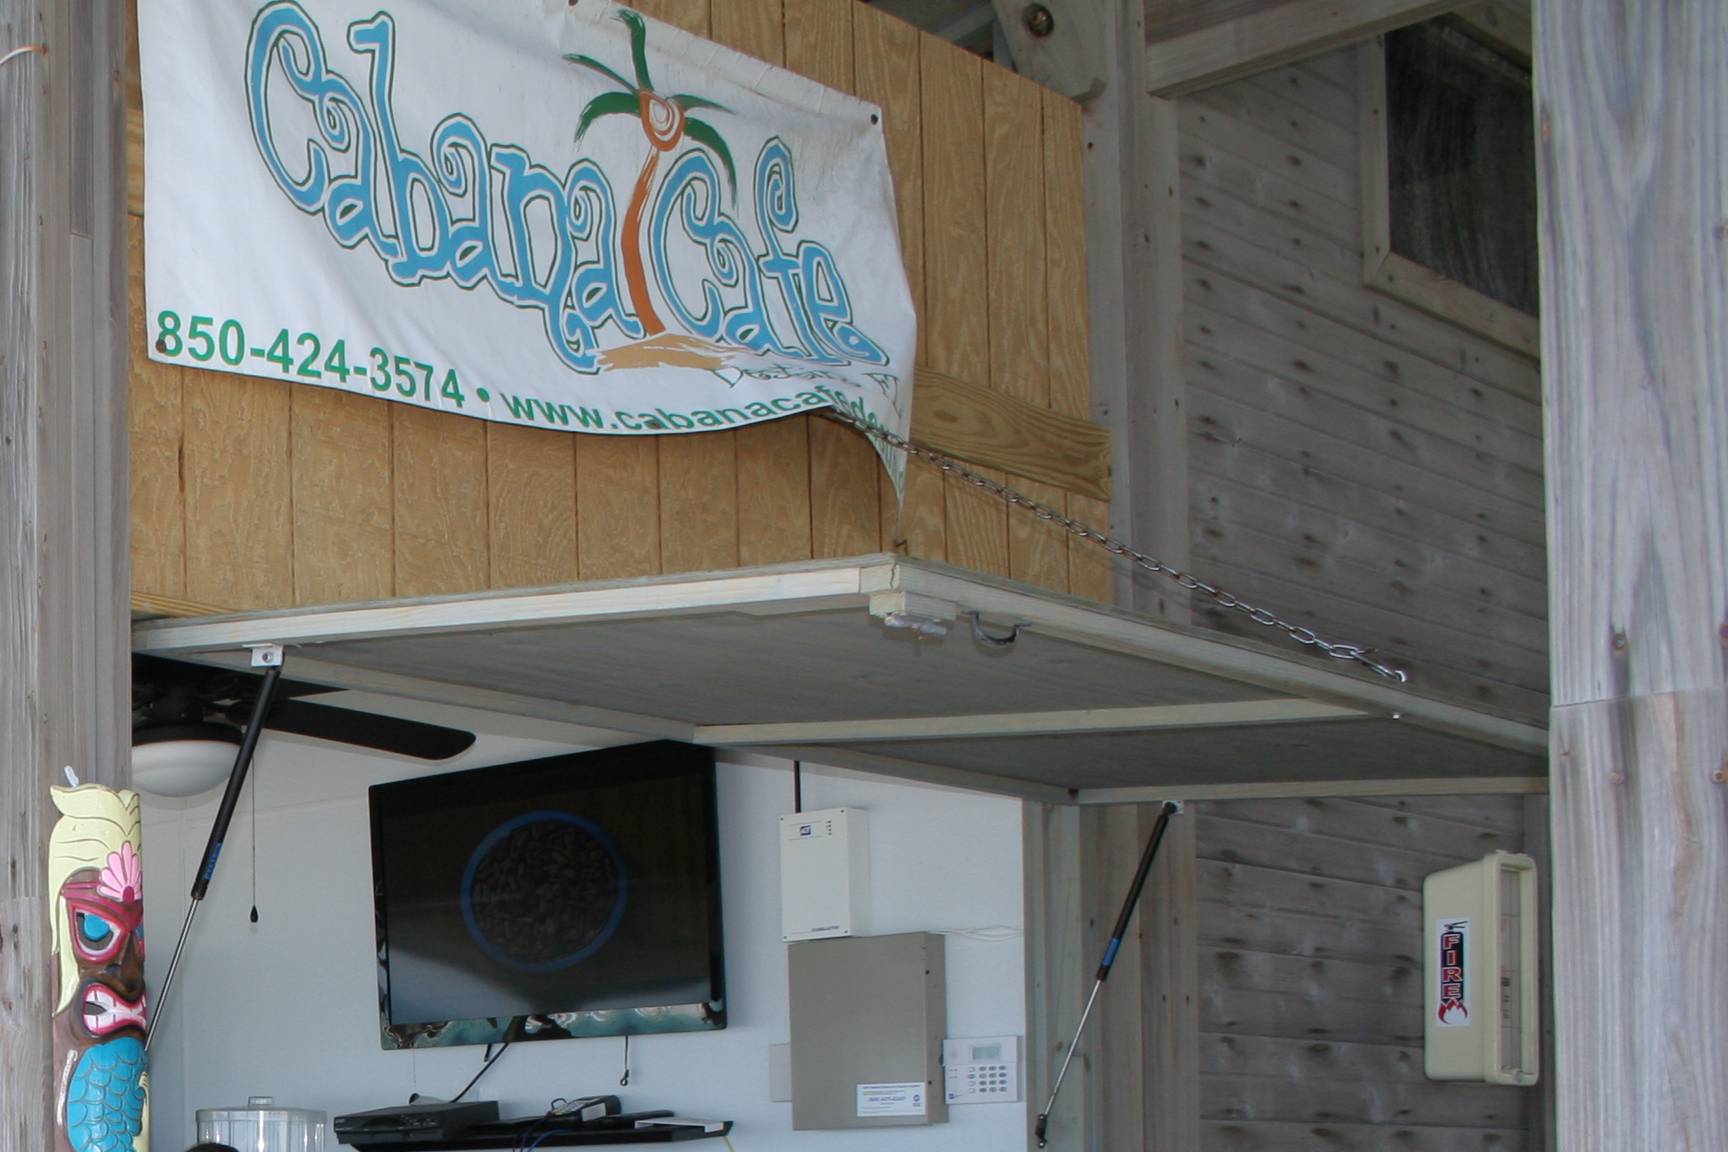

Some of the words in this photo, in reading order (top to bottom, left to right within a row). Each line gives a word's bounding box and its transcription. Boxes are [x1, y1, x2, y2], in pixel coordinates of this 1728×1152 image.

[244, 2, 648, 374] Cabana
[651, 136, 891, 367] Cafe
[156, 309, 466, 408] 850-424-3574
[1442, 933, 1464, 1000] FIRE
